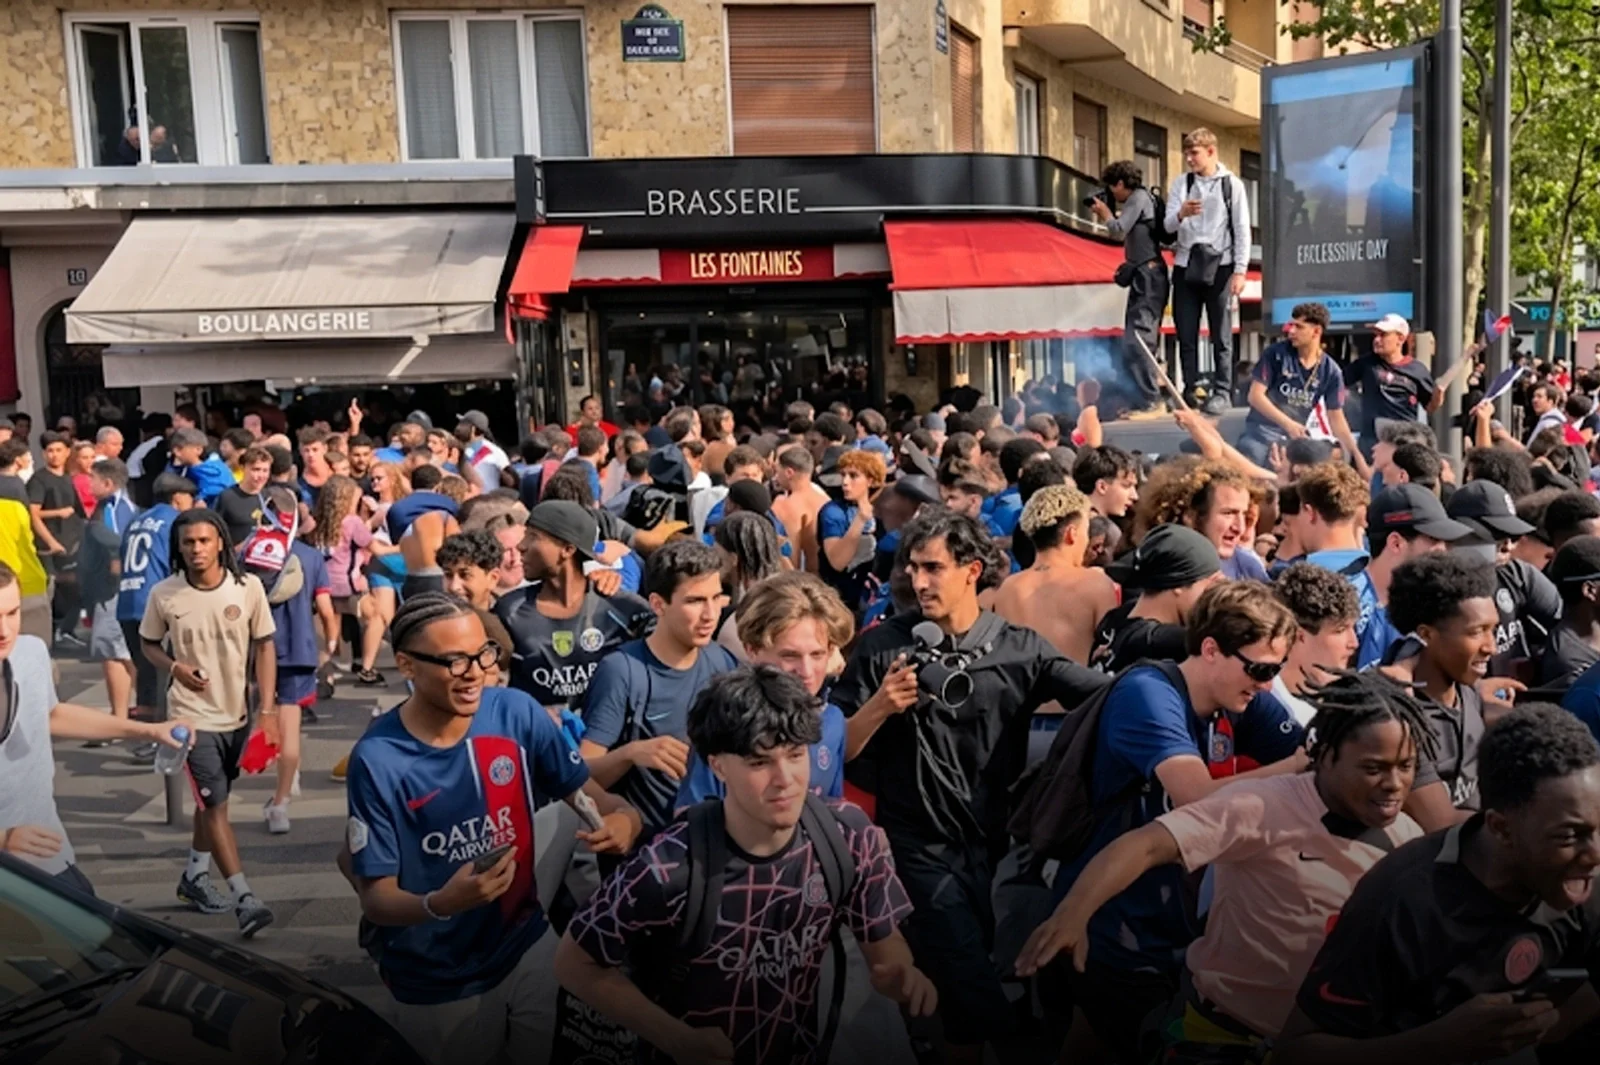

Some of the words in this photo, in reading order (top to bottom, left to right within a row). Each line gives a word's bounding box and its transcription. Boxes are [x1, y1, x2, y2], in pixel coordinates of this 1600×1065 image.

[647, 188, 801, 216] BRASSERIE
[690, 253, 717, 278] LES
[720, 251, 803, 277] FONTAINES
[198, 311, 371, 334] BOULANGERIE
[422, 806, 513, 856] QATAR
